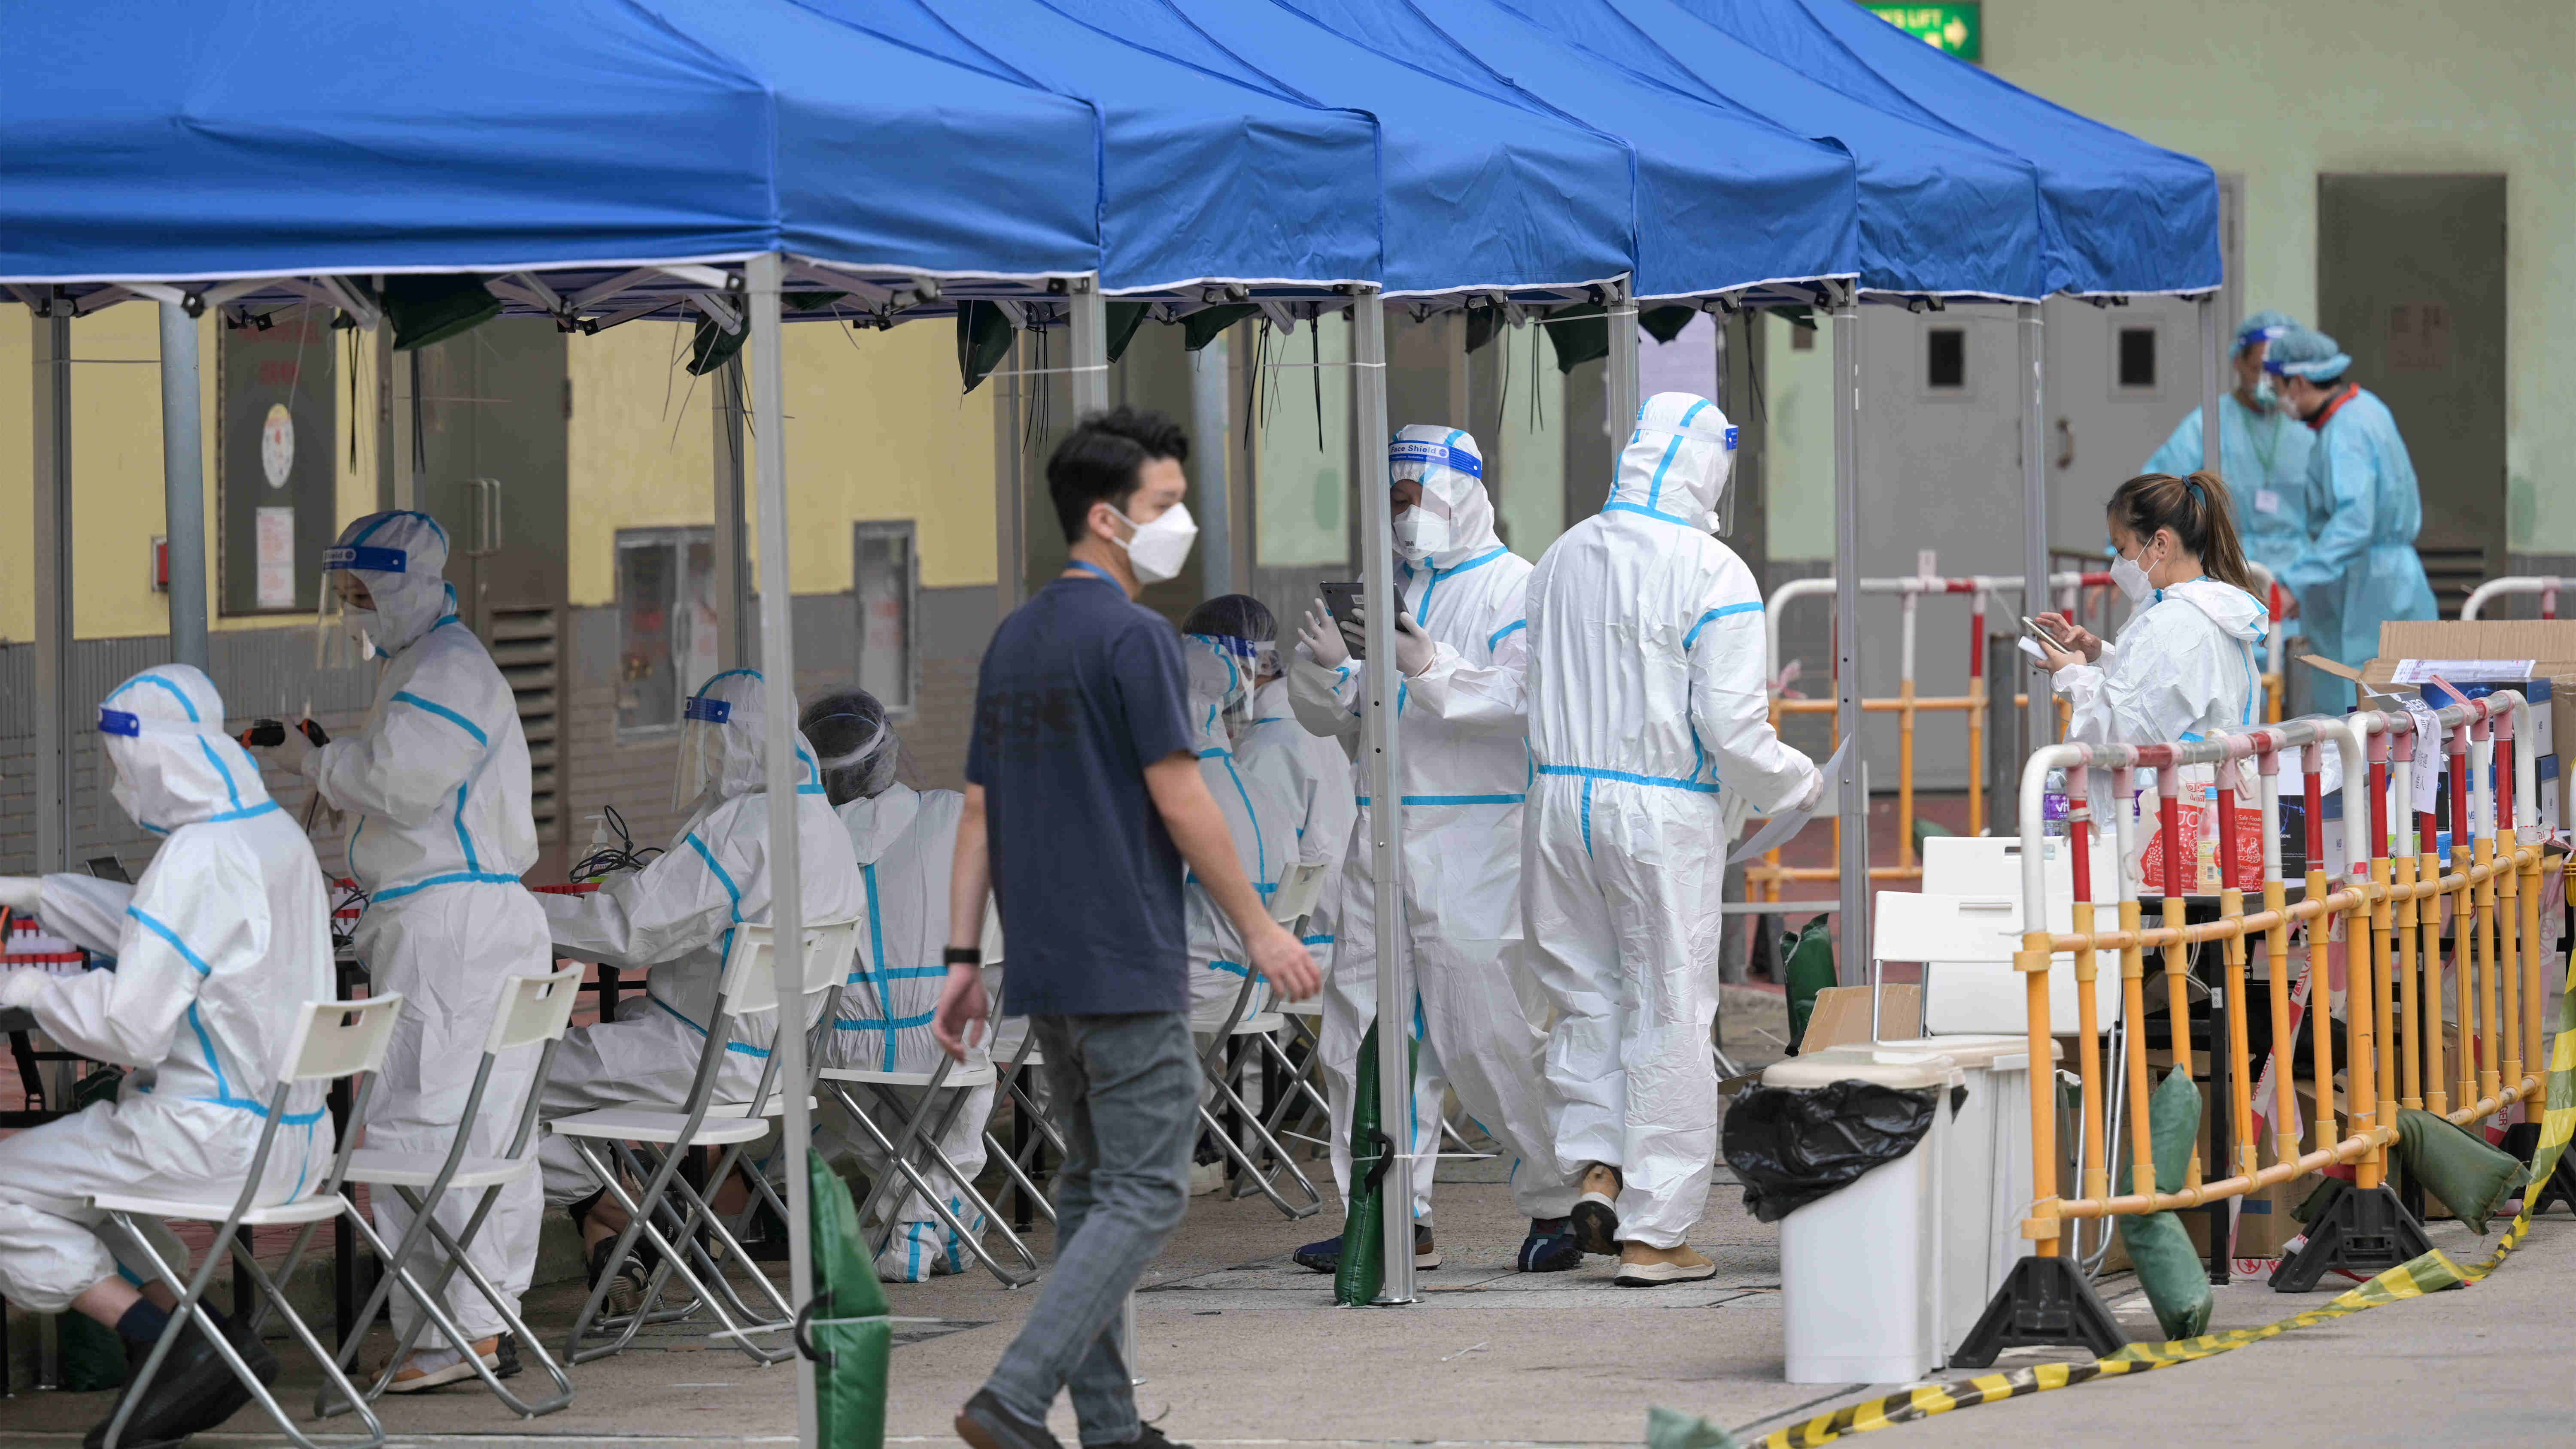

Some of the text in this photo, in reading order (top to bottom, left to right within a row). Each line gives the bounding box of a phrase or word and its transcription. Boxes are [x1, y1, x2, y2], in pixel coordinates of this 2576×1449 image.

[1908, 9, 1942, 28] LIFT
[1408, 445, 1437, 454] Shield
[2498, 1106, 2508, 1126] GER
